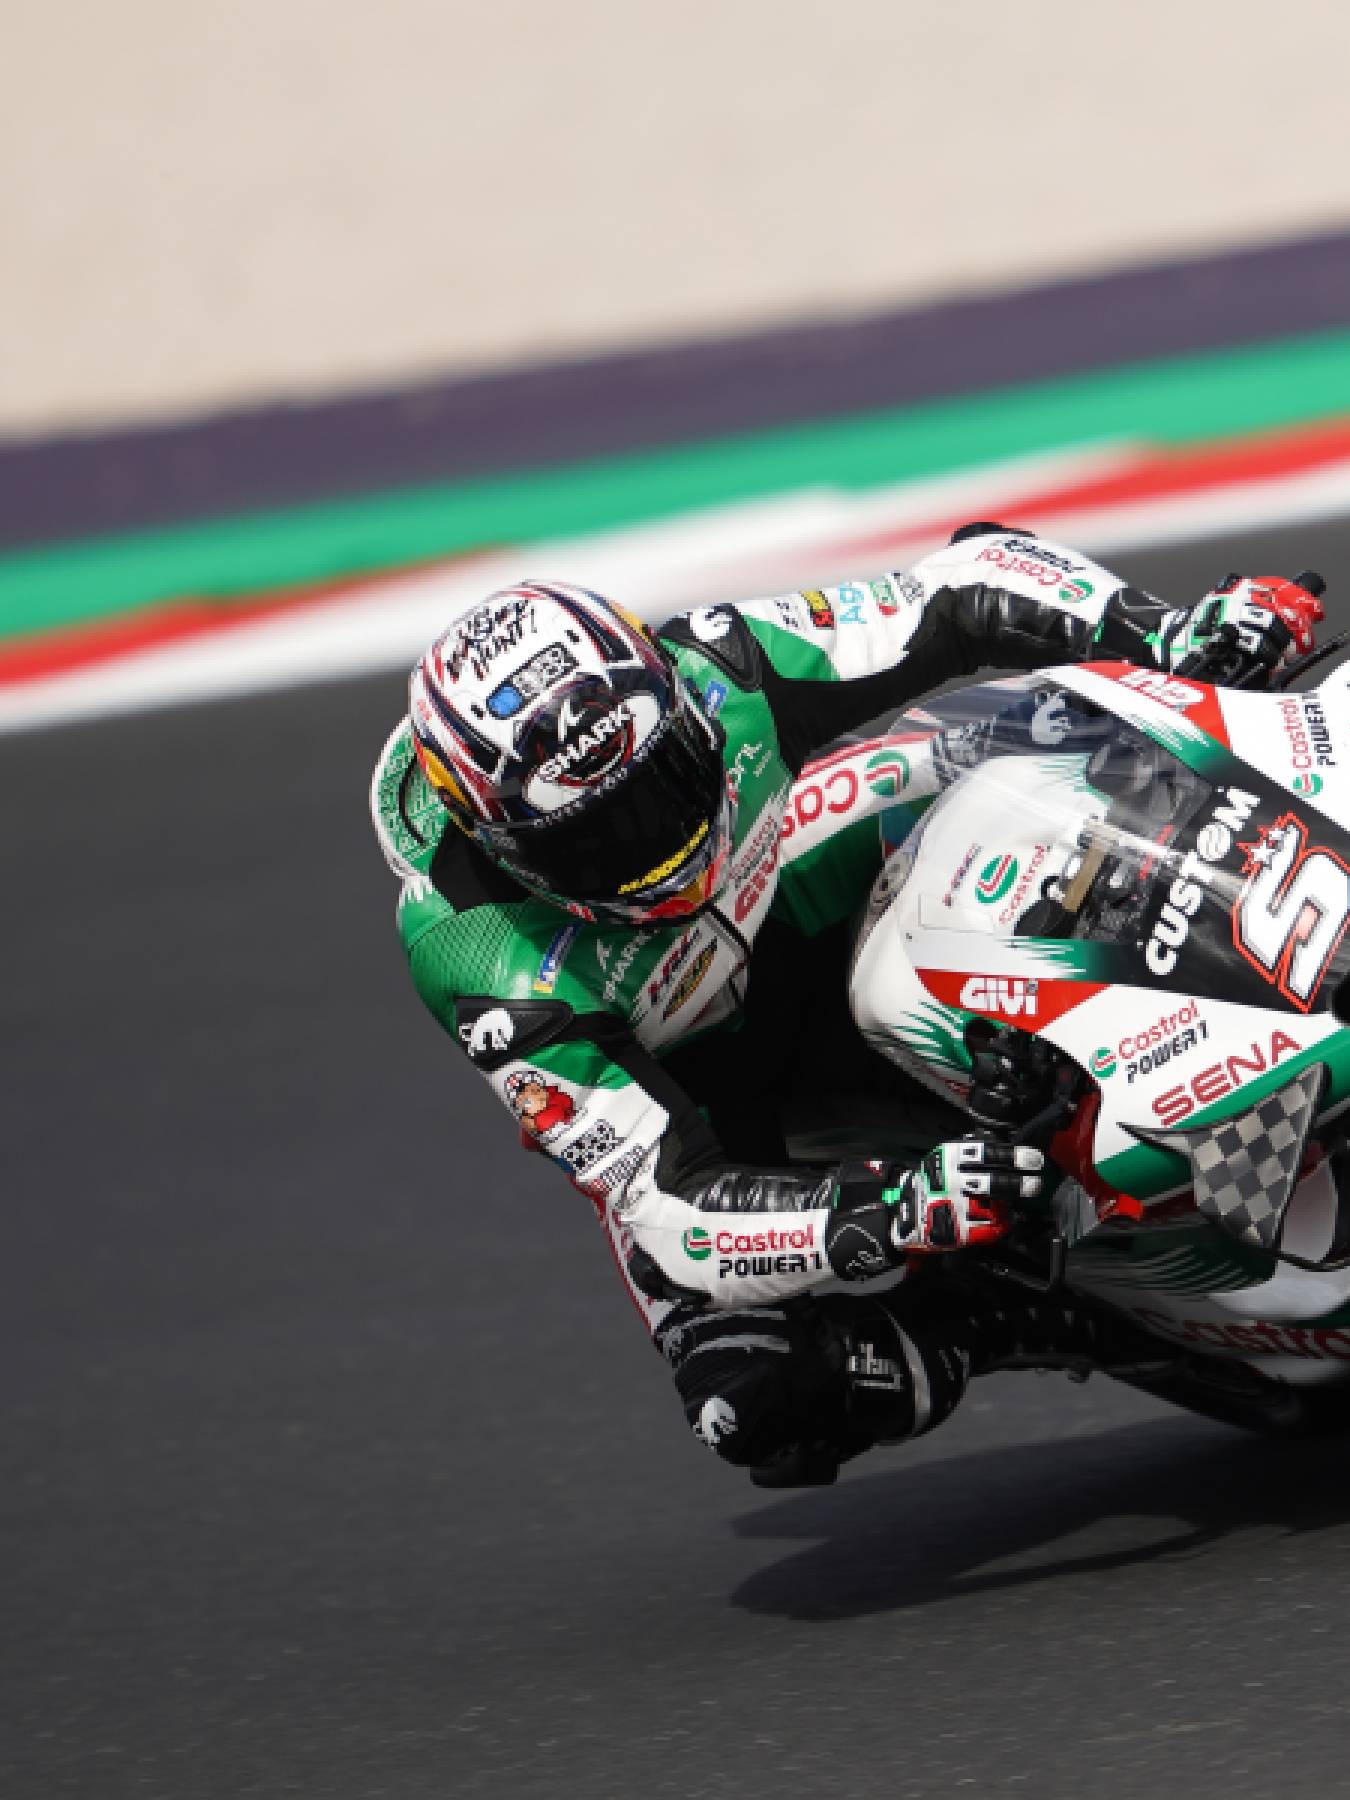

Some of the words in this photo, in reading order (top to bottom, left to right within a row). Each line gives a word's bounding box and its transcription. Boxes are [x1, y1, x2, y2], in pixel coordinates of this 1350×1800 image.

[975, 547, 1063, 586] Castrol
[541, 704, 631, 783] SHARK
[1276, 697, 1313, 770] Castrol
[1301, 692, 1336, 767] POWER1
[999, 843, 1047, 925] Castrol
[1144, 785, 1262, 977] CUSTOM
[1117, 999, 1200, 1061] Castrol
[1125, 1020, 1209, 1084] POWER1
[1152, 1030, 1300, 1127] SENA
[715, 1223, 815, 1256] Castrol
[718, 1251, 822, 1279] POWER1
